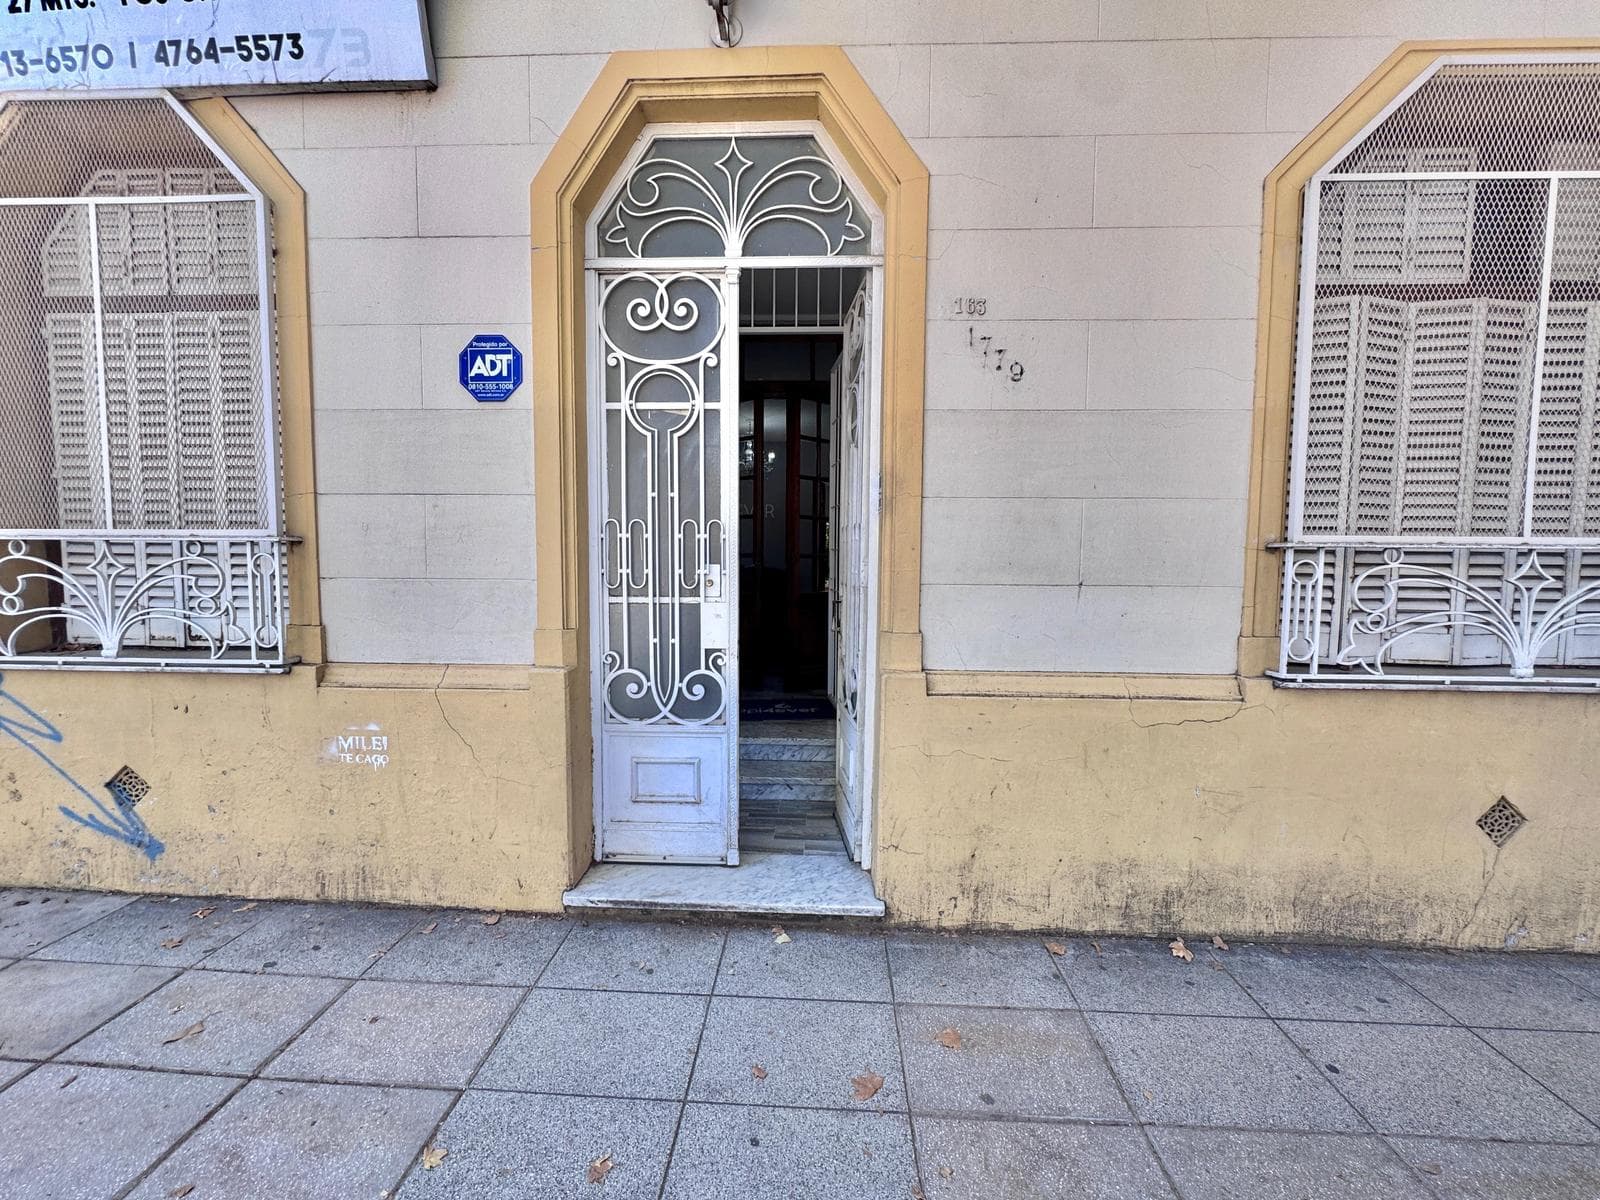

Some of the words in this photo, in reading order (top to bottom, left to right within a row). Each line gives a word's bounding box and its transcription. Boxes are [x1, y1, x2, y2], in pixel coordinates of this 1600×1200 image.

[154, 32, 304, 67] 4764-5573
[954, 298, 987, 316] 163
[469, 354, 512, 377] ADT
[338, 735, 388, 752] MILEI
[339, 753, 353, 764] TE
[355, 754, 389, 766] CAGO
